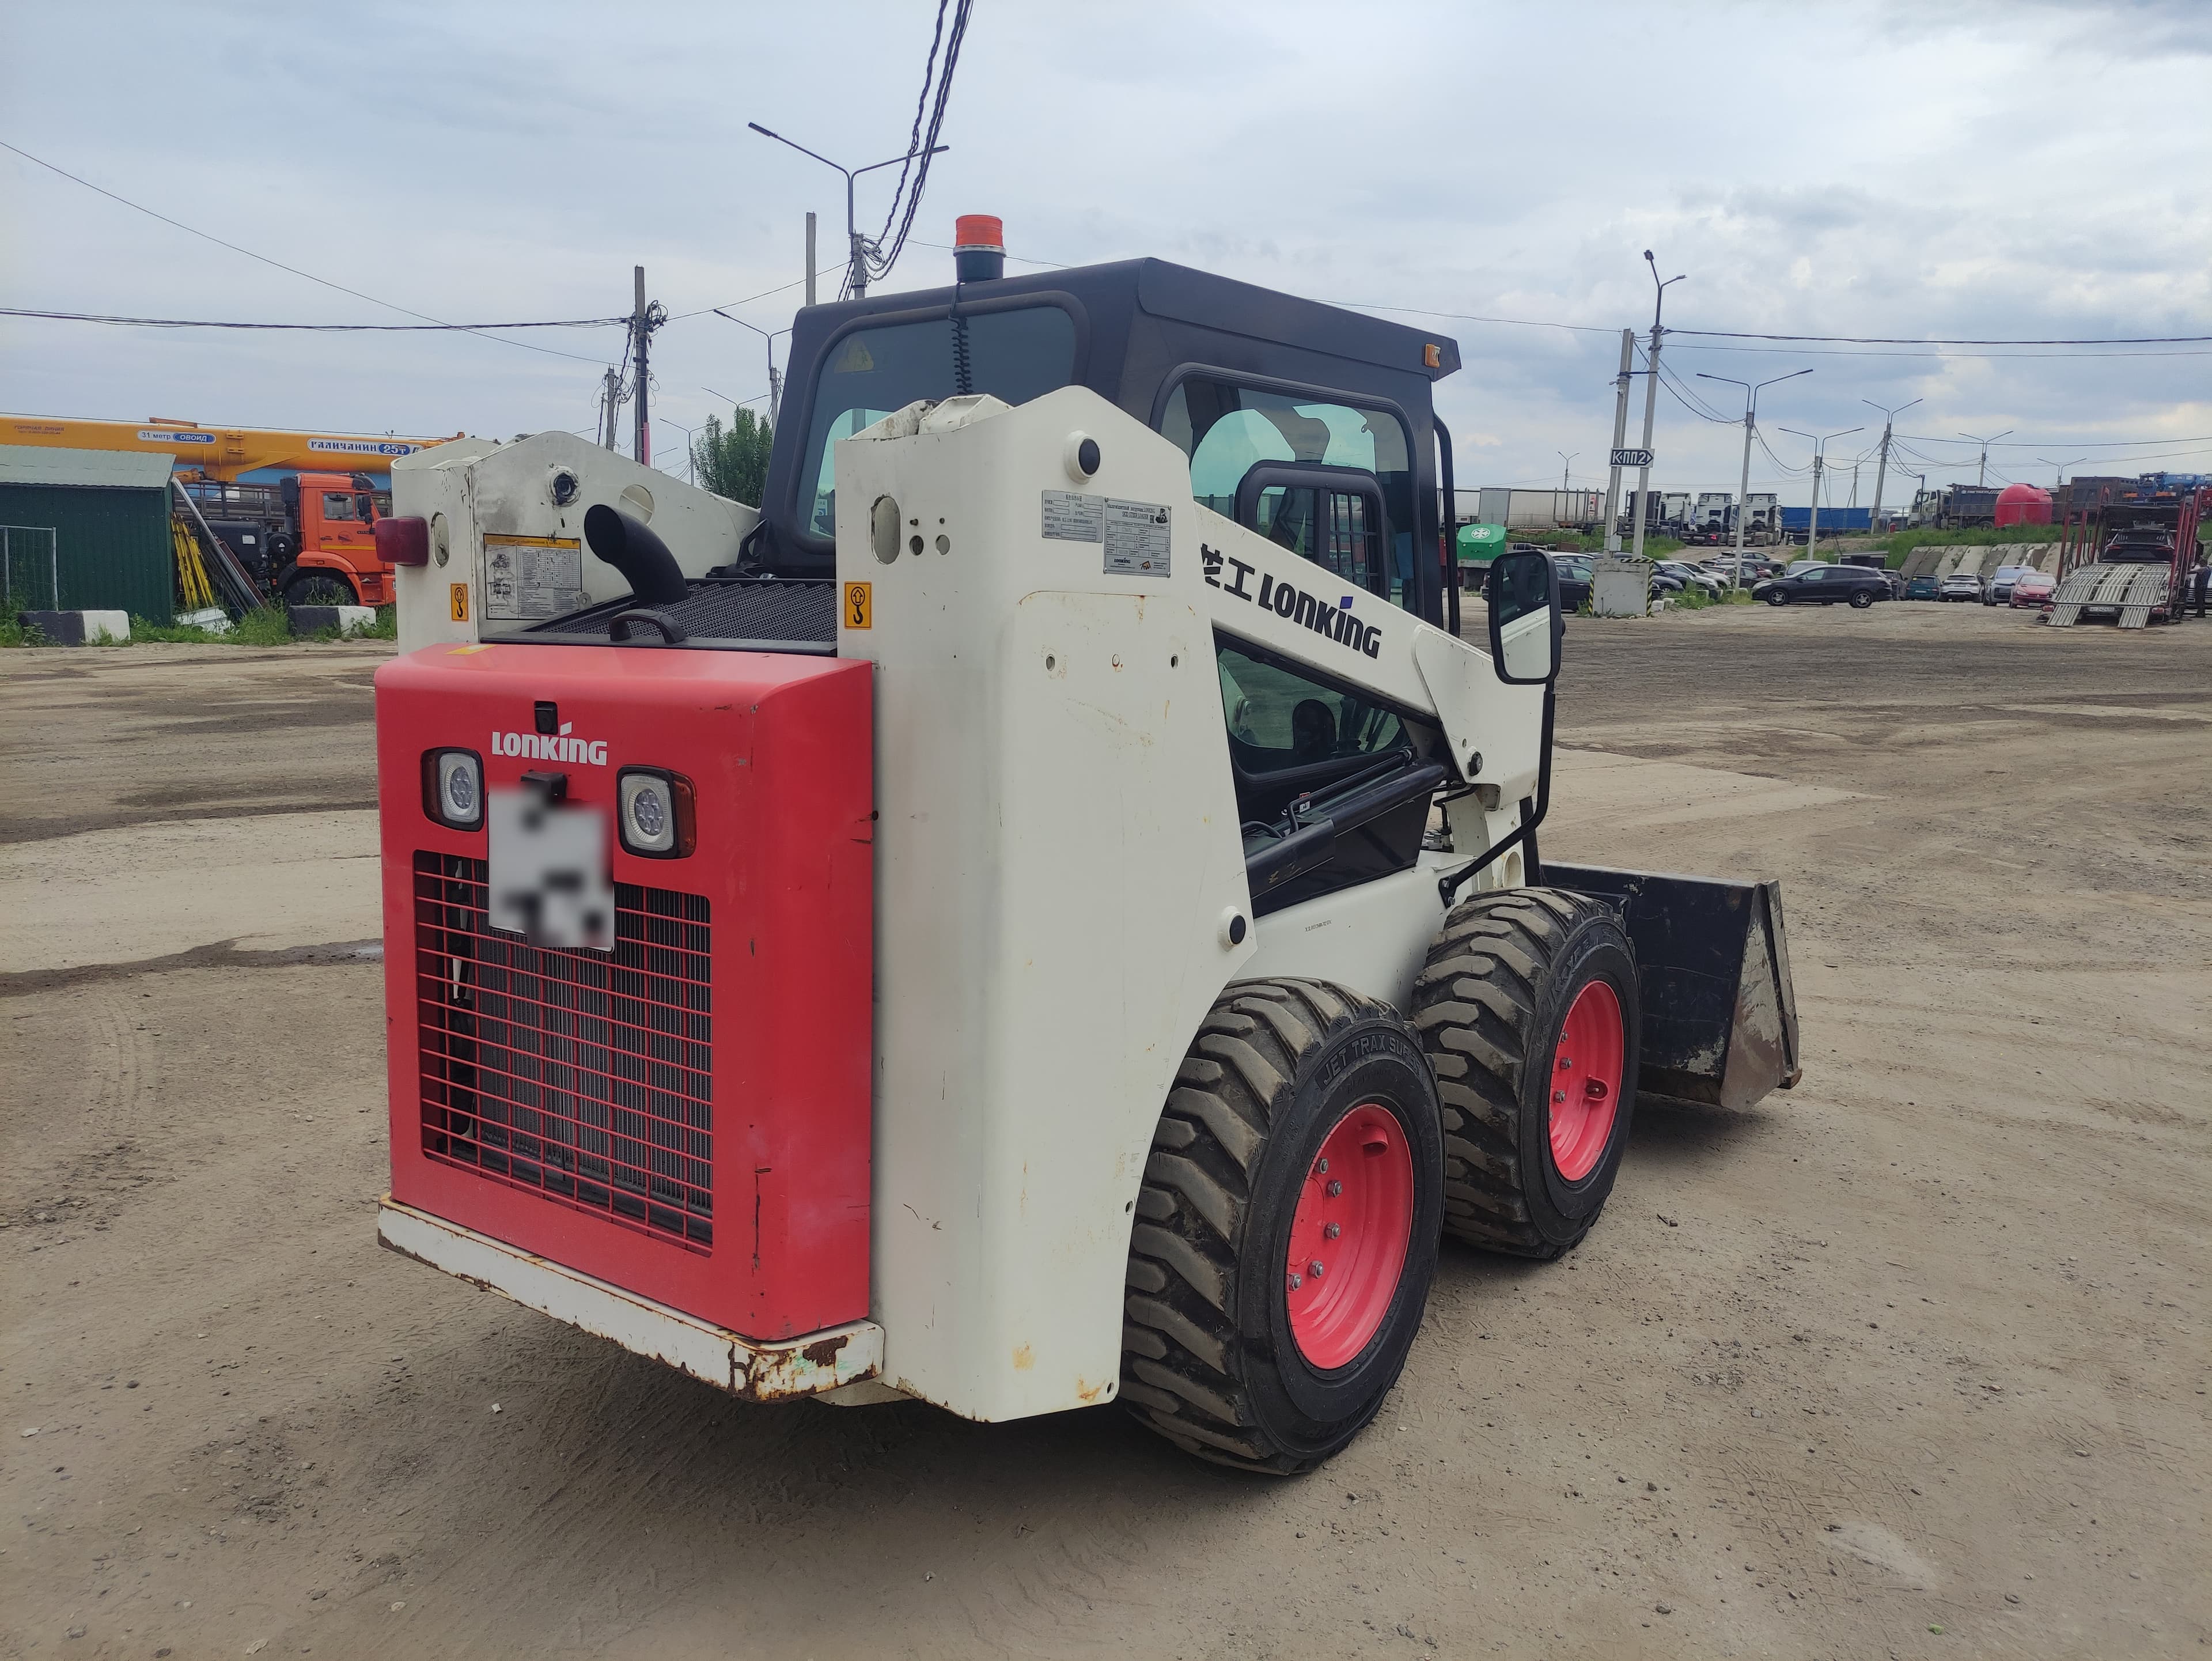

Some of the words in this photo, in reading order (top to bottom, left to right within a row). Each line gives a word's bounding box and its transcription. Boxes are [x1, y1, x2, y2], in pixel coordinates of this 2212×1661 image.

[311, 441, 377, 452] ГАЛИЧАНИН
[1612, 451, 1646, 464] КПП2
[1258, 573, 1381, 659] LONKING
[492, 721, 608, 766] LONKING
[1323, 1048, 1347, 1085] JET
[1352, 1035, 1385, 1057] TRAX
